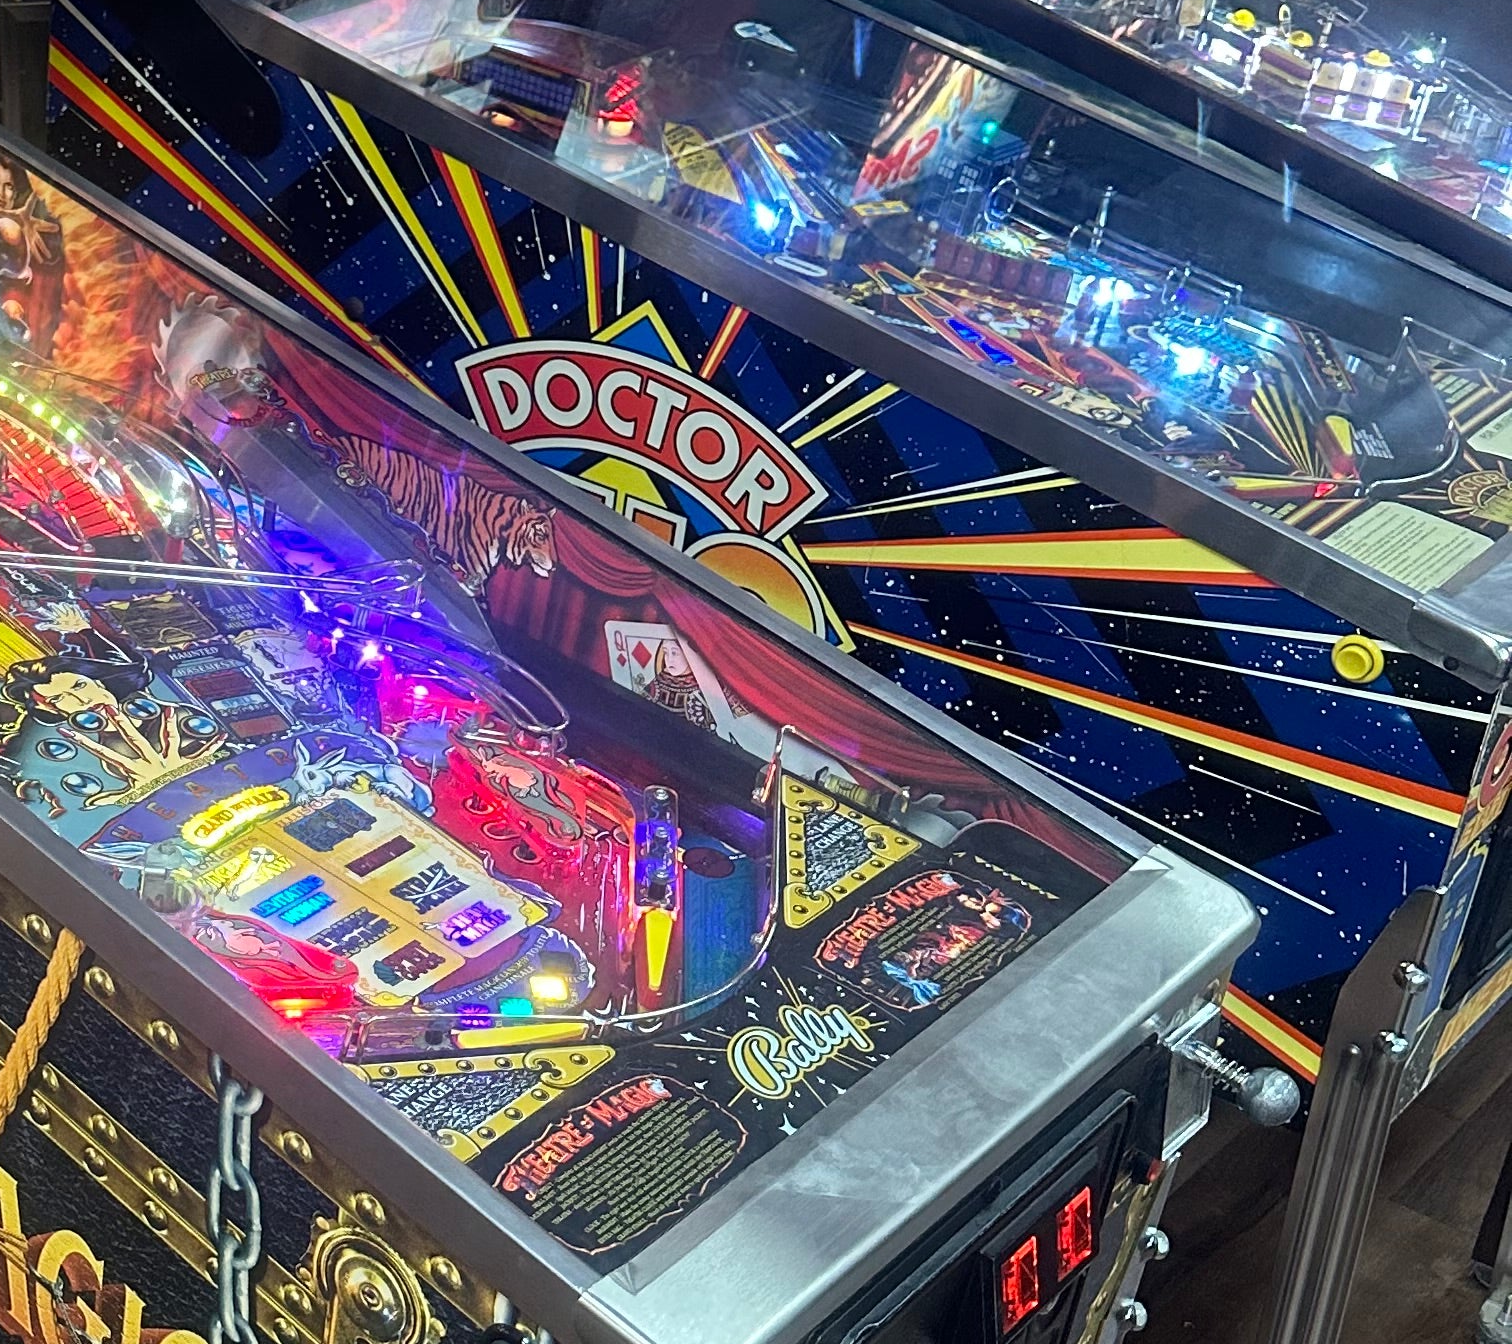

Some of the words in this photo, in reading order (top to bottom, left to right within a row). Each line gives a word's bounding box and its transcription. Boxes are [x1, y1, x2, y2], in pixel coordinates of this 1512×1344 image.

[482, 358, 790, 533] DOCTOR
[1455, 472, 1504, 504] DOCTOR
[169, 646, 218, 661] HAUNTED
[614, 630, 627, 652] Q
[814, 812, 844, 836] LANE
[815, 821, 858, 849] CHANGE
[733, 1007, 869, 1097] Bally
[404, 1082, 452, 1119] HANGE
[502, 1122, 595, 1201] THEATRE
[588, 1078, 673, 1126] MAGIC
